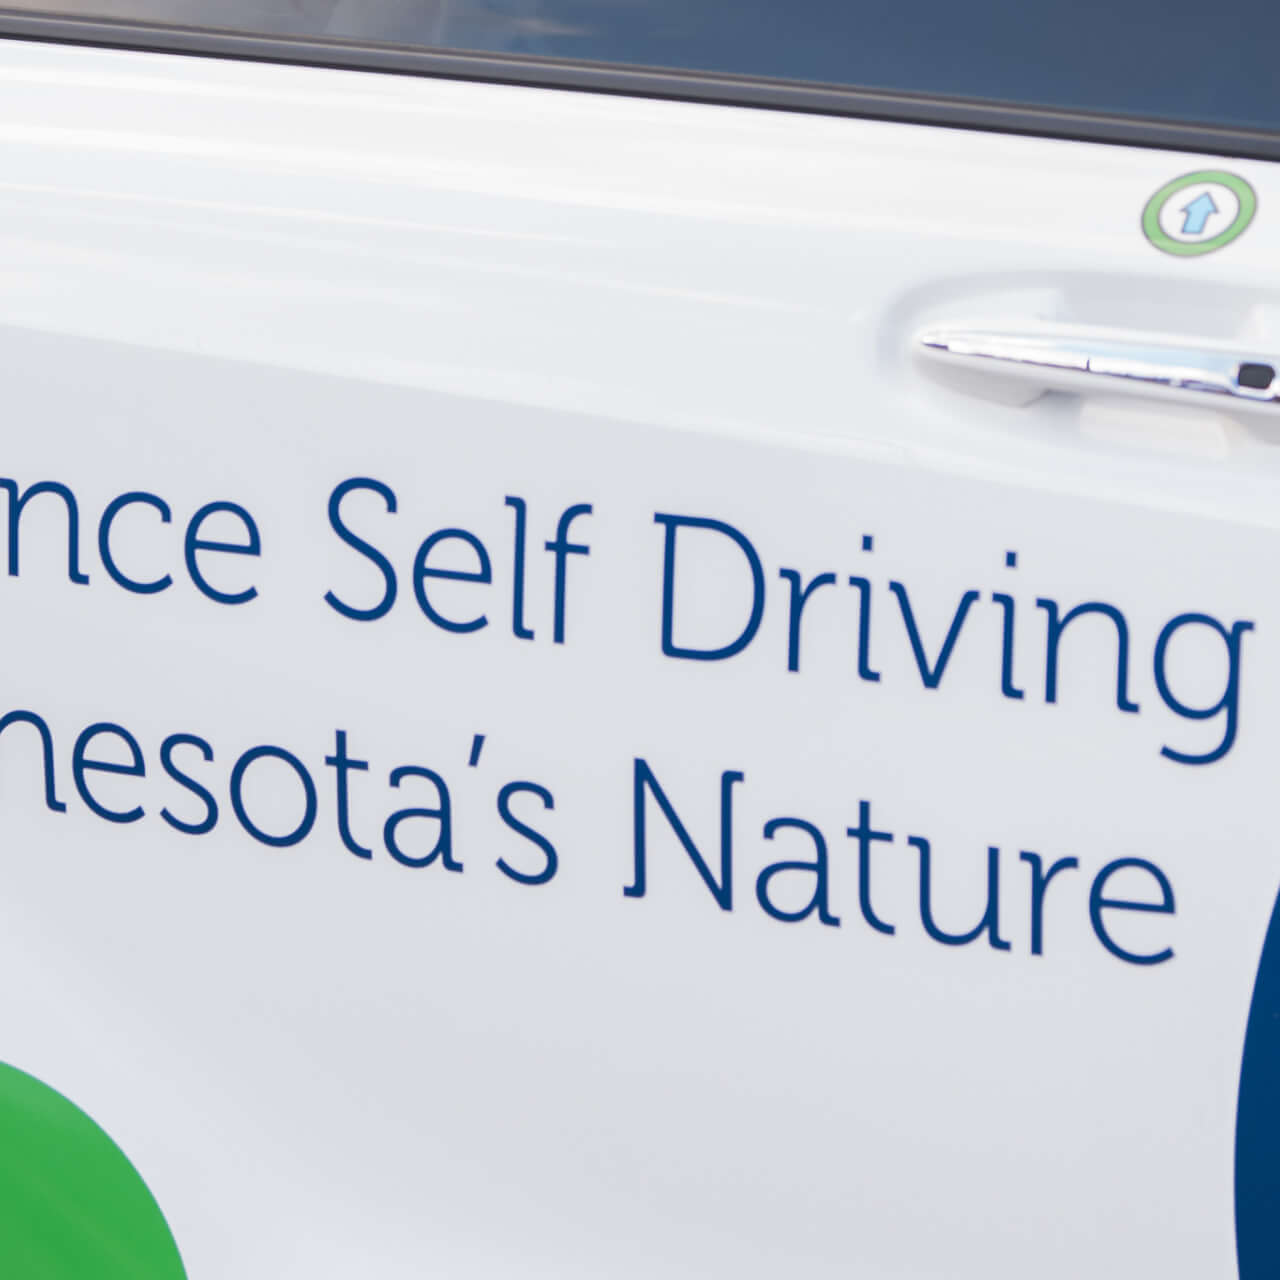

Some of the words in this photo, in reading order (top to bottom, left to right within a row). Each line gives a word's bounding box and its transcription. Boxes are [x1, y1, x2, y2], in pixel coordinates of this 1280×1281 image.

[324, 477, 592, 644] Self
[653, 512, 1256, 766] Driving
[622, 757, 1177, 966] Nature
